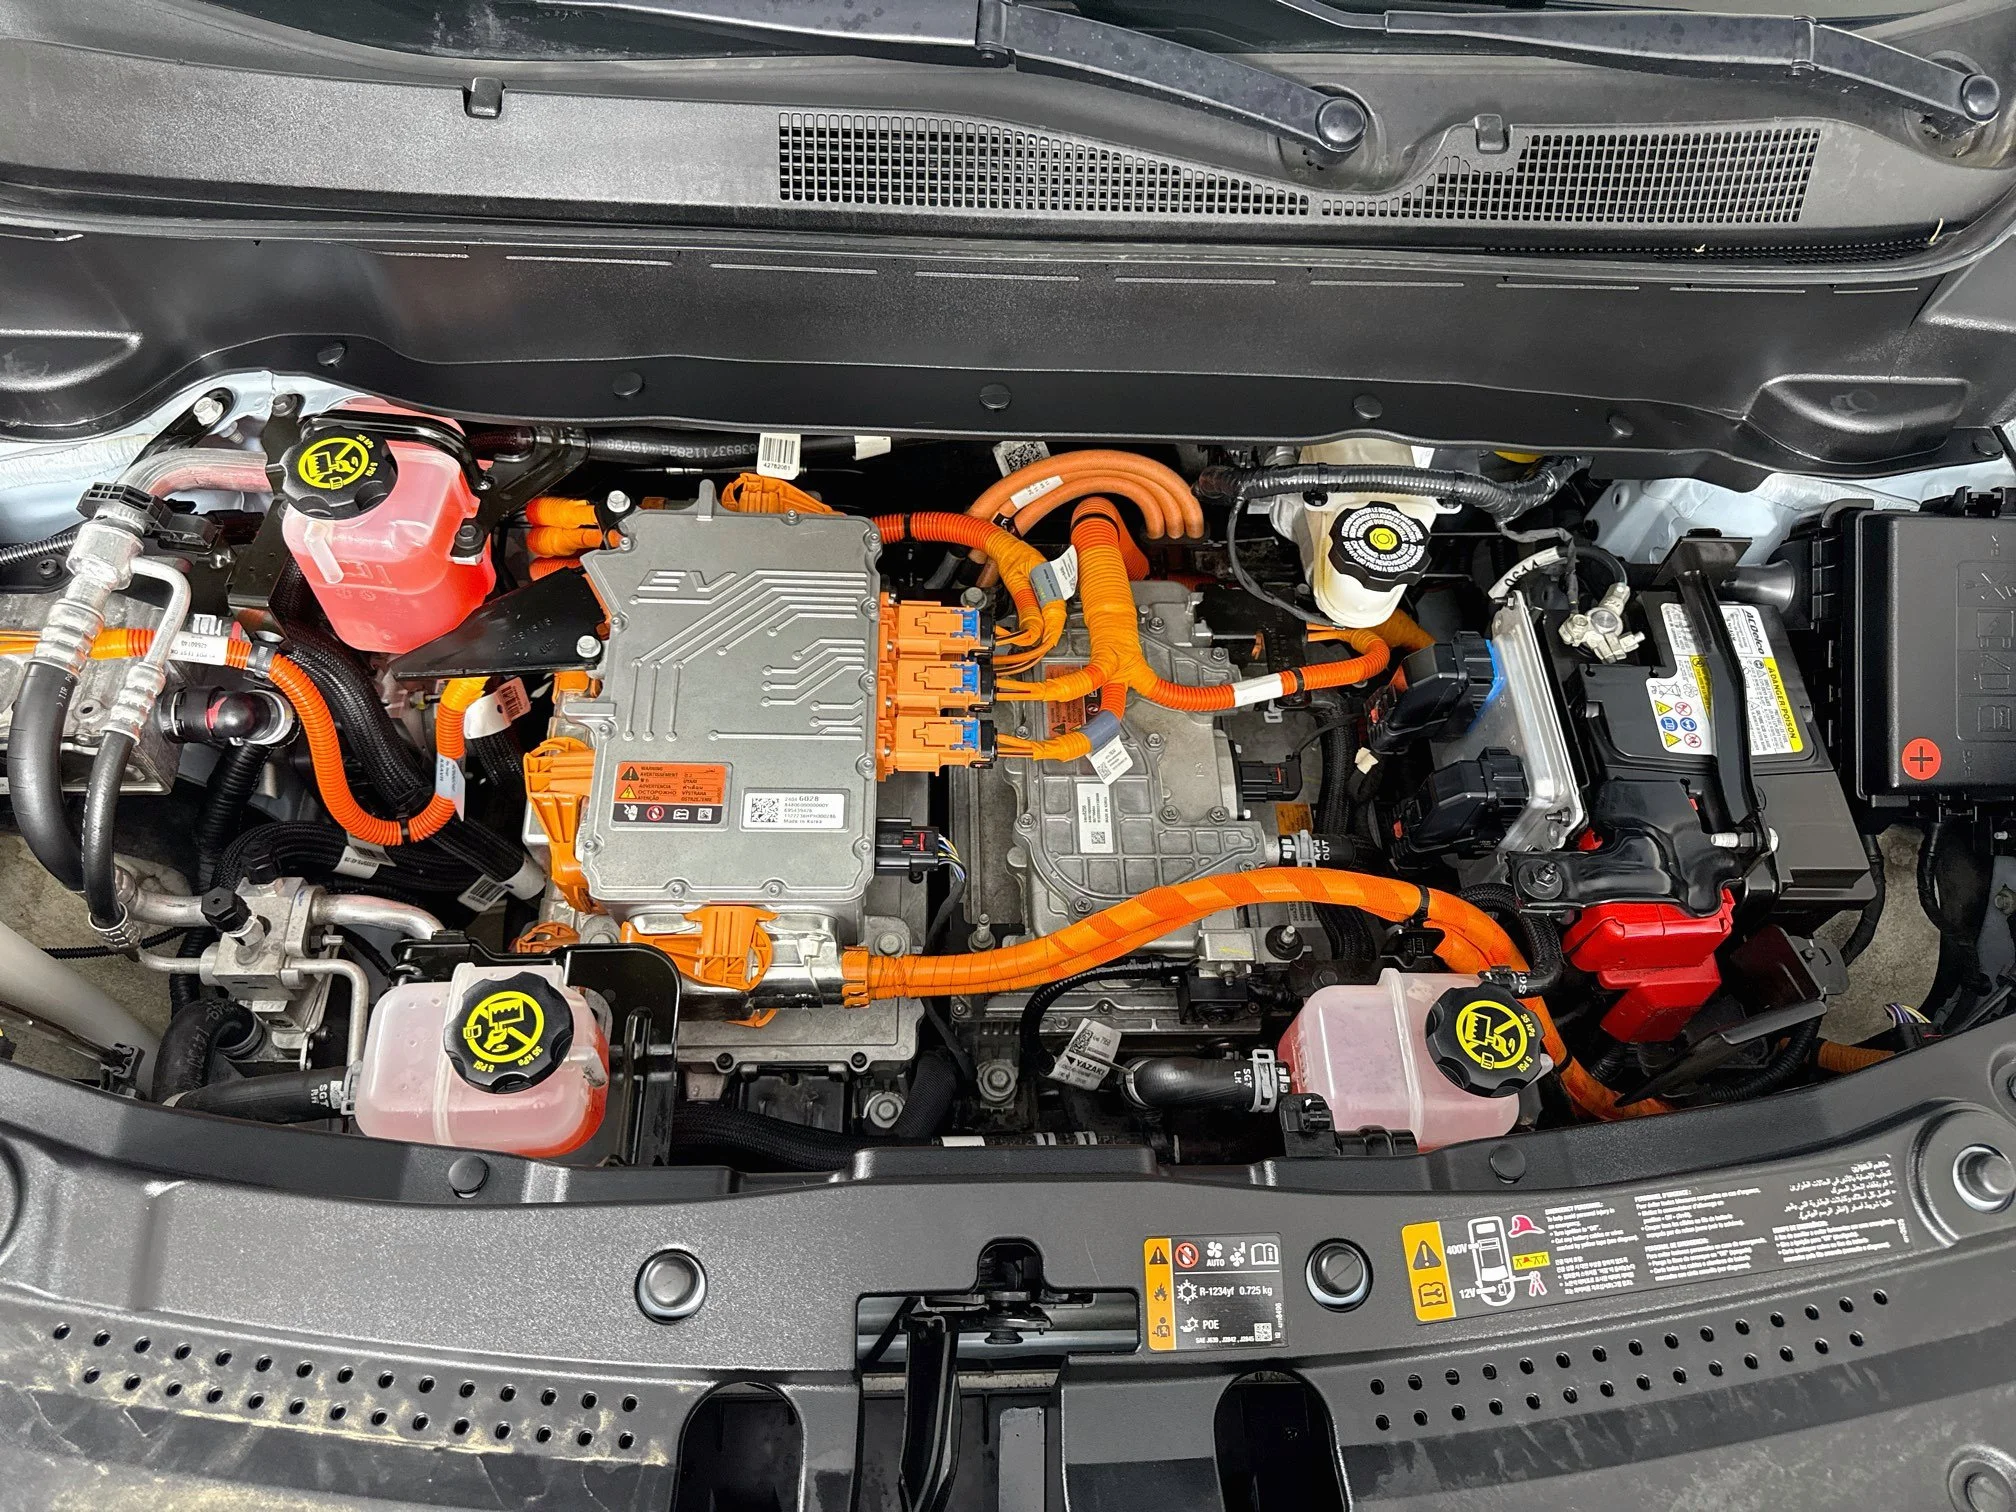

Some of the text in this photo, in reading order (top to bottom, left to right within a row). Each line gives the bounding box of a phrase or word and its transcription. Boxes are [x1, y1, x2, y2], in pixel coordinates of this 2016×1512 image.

[1744, 608, 1766, 655] ACDelco
[1320, 839, 1331, 861] OUT
[1526, 1023, 1536, 1038] kPa
[473, 1060, 489, 1071] PSI
[1076, 1058, 1105, 1076] YAZAKI
[1517, 1060, 1530, 1073] PSI
[1242, 1067, 1253, 1088] SGT
[318, 1082, 329, 1107] SGT
[1445, 1242, 1468, 1256] 400V
[1205, 1258, 1225, 1266] AUTO
[1198, 1285, 1273, 1297] R-1234yf 0.725 kg
[1458, 1286, 1477, 1299] 12V
[1202, 1319, 1219, 1329] POE
